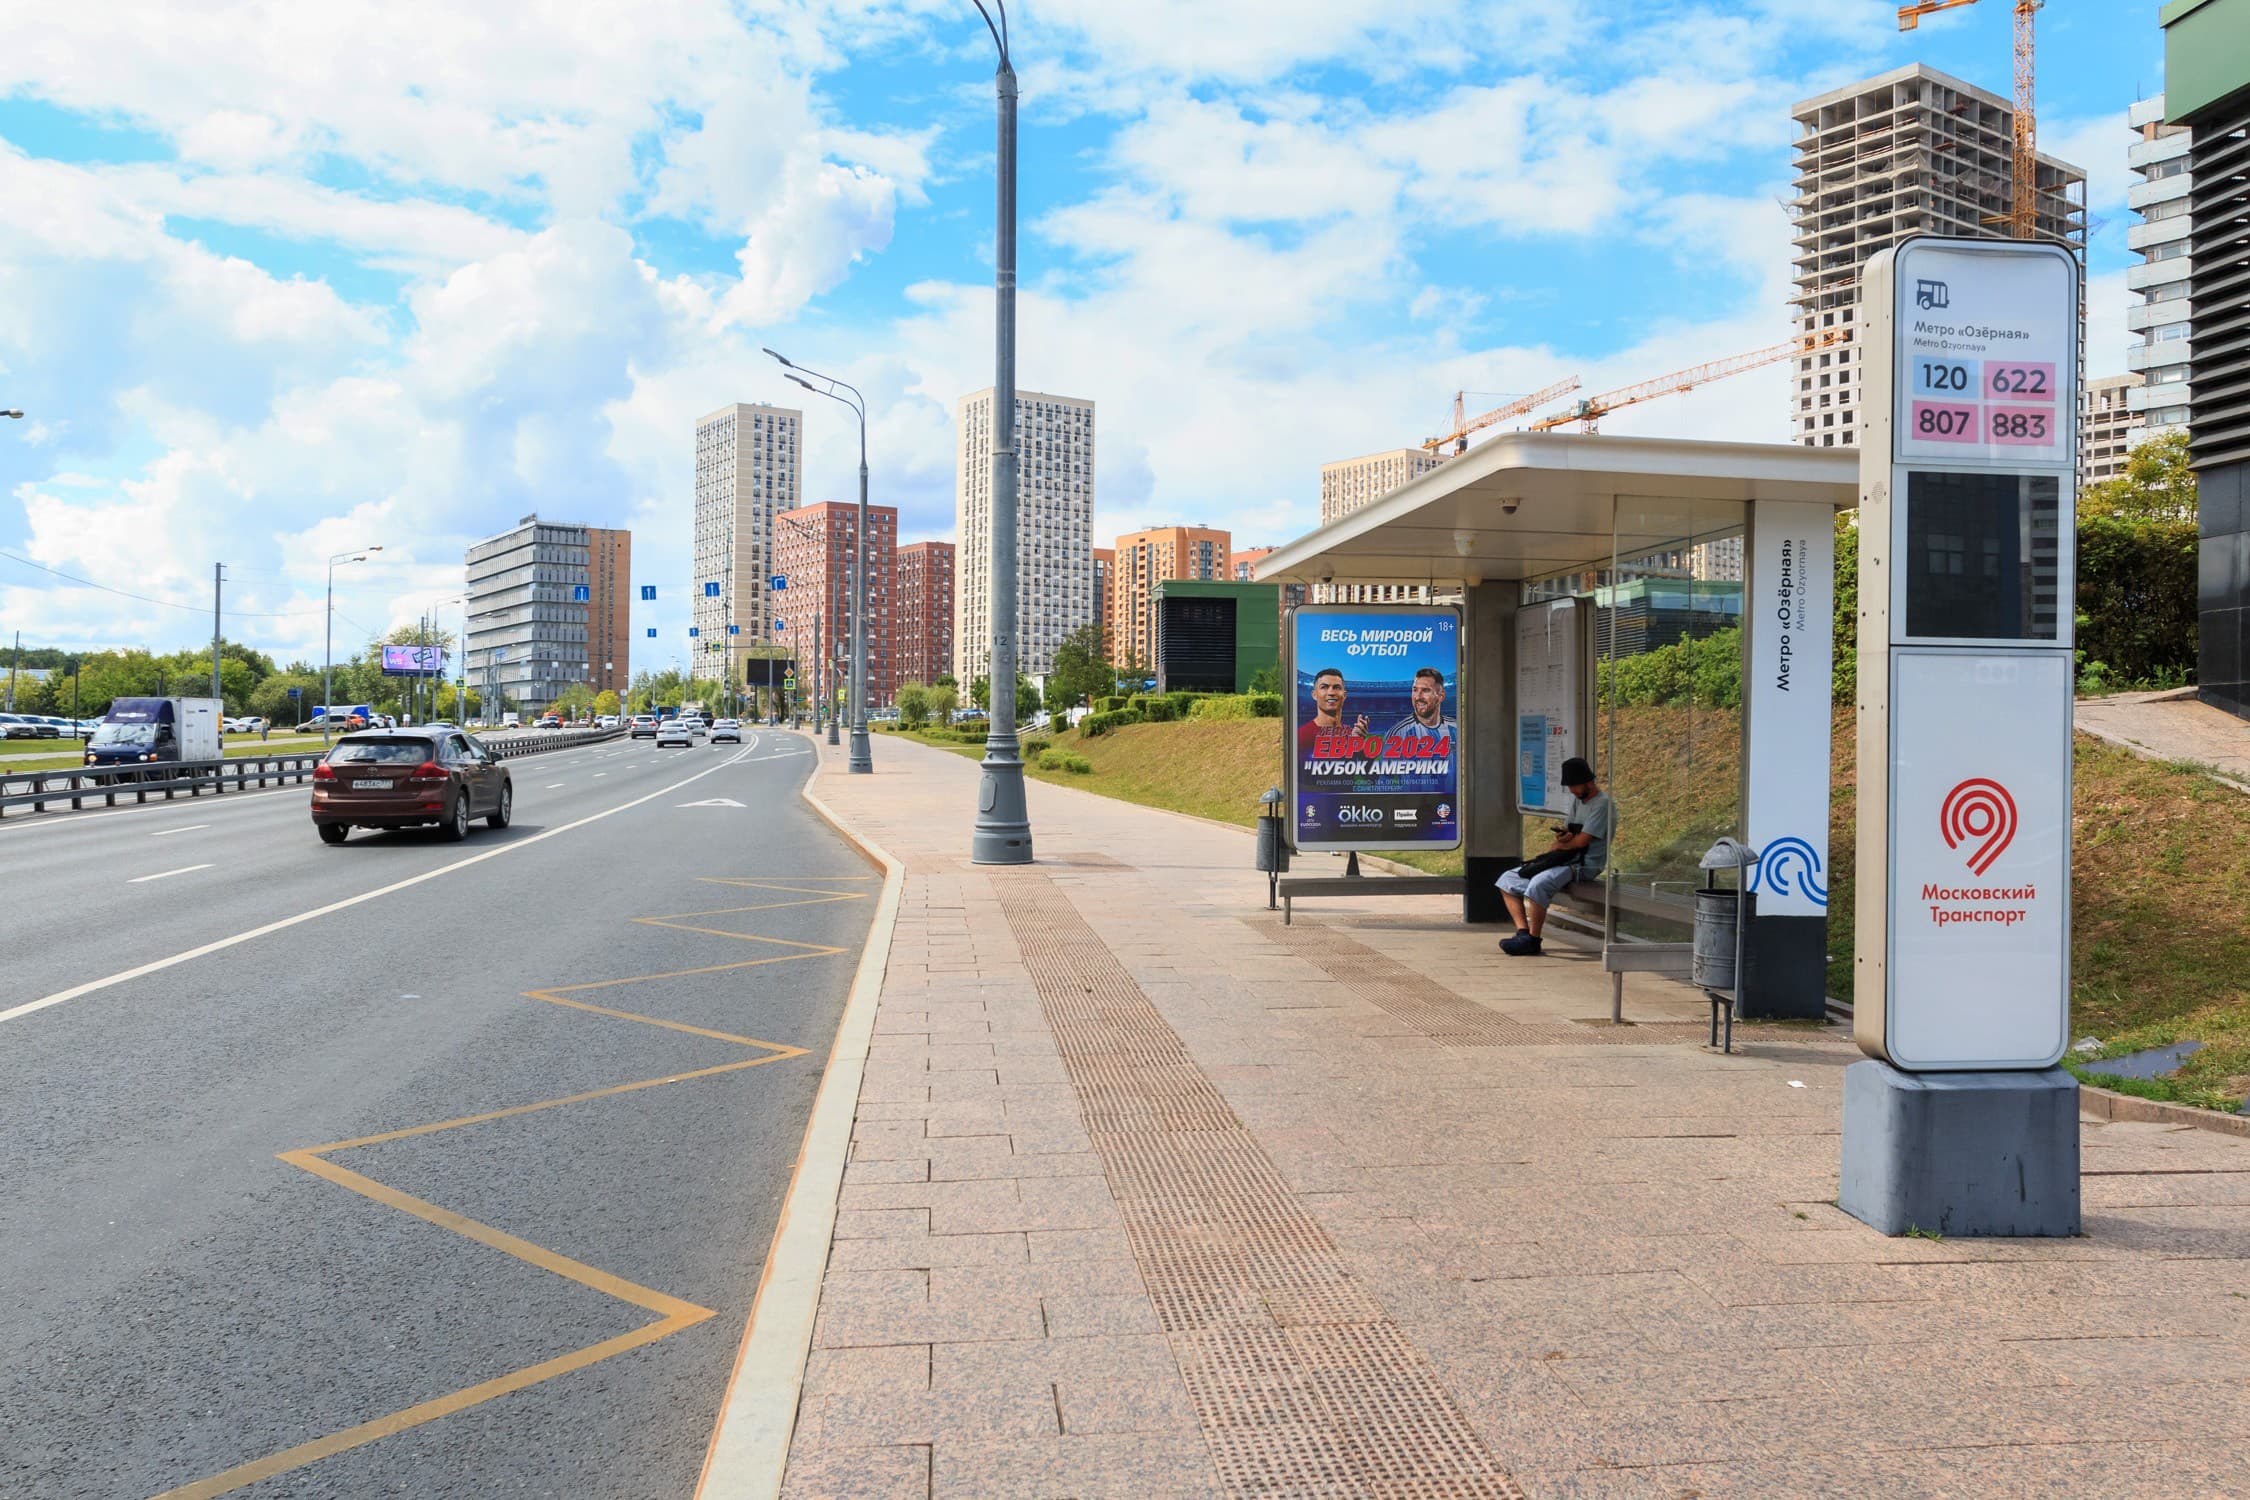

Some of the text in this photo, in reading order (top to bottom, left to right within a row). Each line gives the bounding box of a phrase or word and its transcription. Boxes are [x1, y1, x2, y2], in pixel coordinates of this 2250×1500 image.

[1914, 321, 2030, 341] Метро «Озёрная»
[1913, 338, 1986, 352] Metro Ozyornaya
[1923, 364, 2047, 394] 120 622
[1919, 409, 2046, 439] 807 883
[1796, 539, 1807, 632] Metro Ozyornaya
[1777, 539, 1794, 692] Метро «Озёрная»
[1320, 627, 1433, 643] ВЕСЬ МИРОВОЙ
[1438, 621, 1455, 632] 18+
[994, 635, 1008, 646] 12
[1346, 644, 1408, 656] ФУТБОЛ
[1312, 735, 1451, 758] ЕВРО 2024
[1369, 760, 1449, 775] АМЕРИКИ
[1922, 884, 2035, 900] Московский
[1930, 906, 2026, 927] Транспорт
